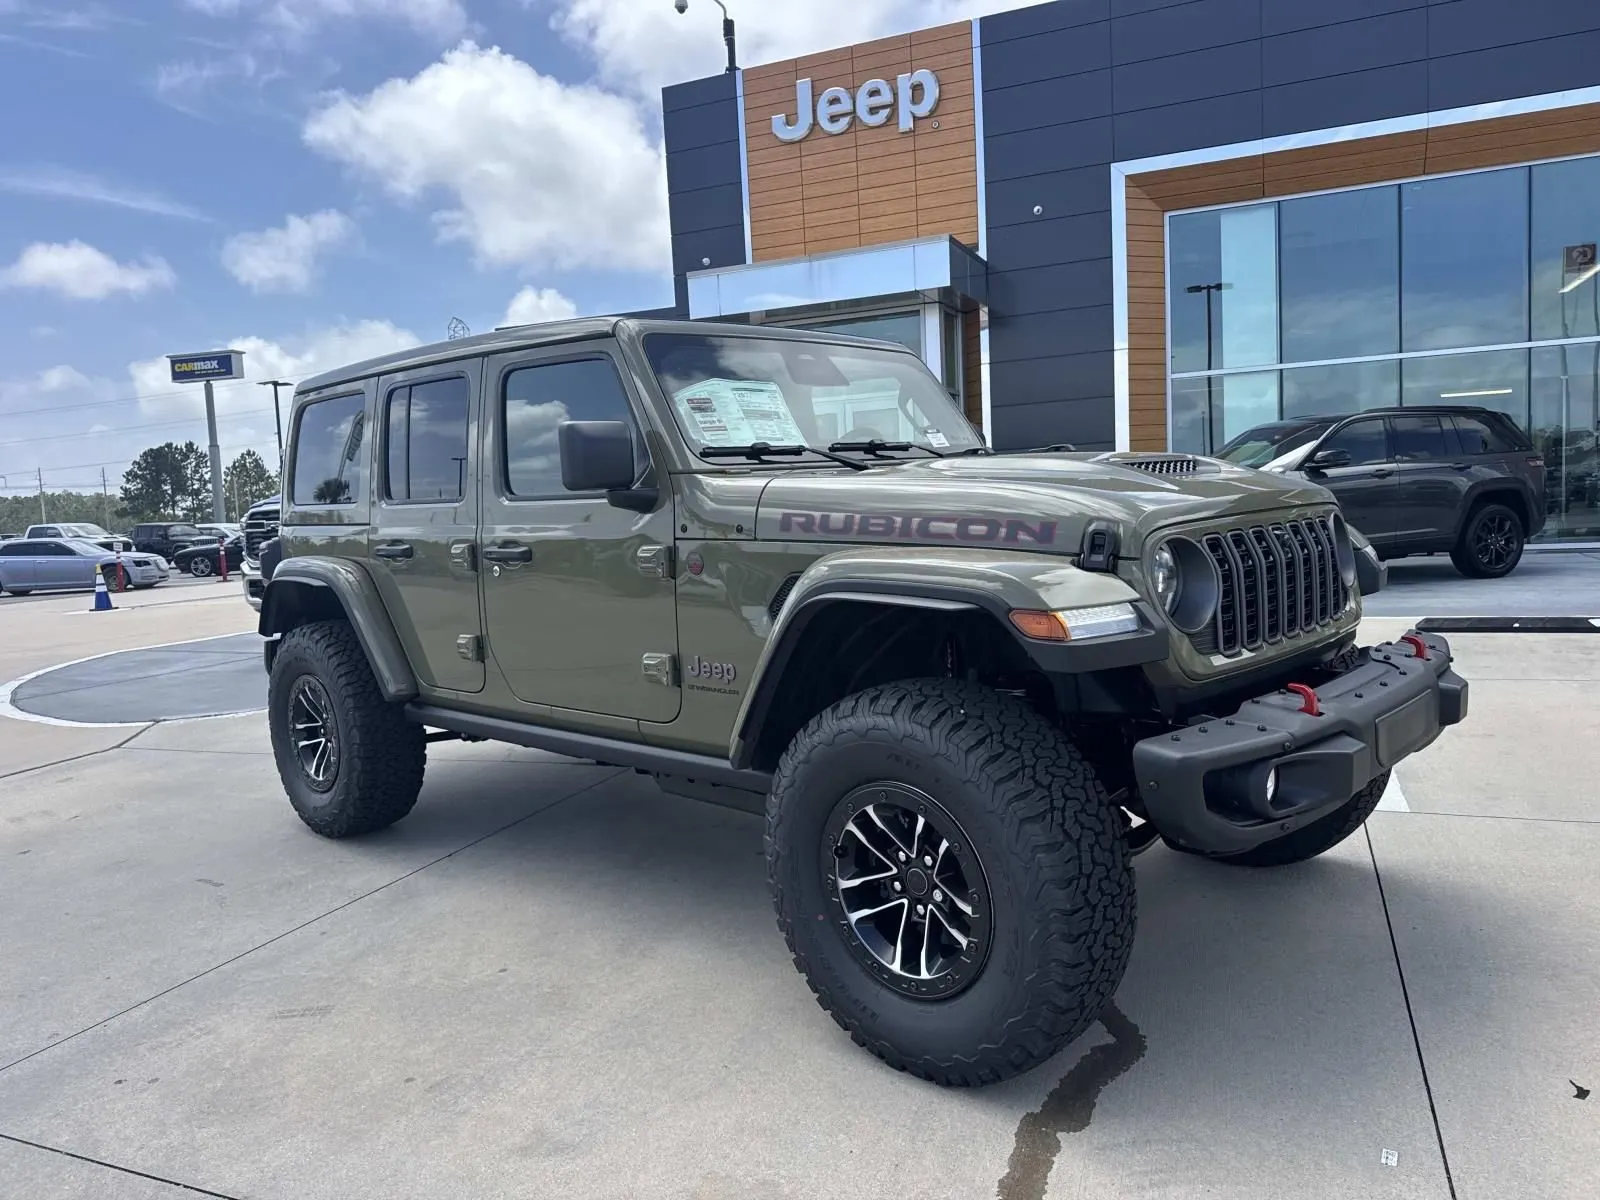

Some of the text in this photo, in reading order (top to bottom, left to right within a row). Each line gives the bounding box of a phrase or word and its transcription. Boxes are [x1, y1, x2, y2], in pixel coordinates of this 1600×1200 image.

[771, 68, 940, 143] Jeep
[779, 512, 1058, 545] RUBICON
[687, 655, 737, 685] Jeep
